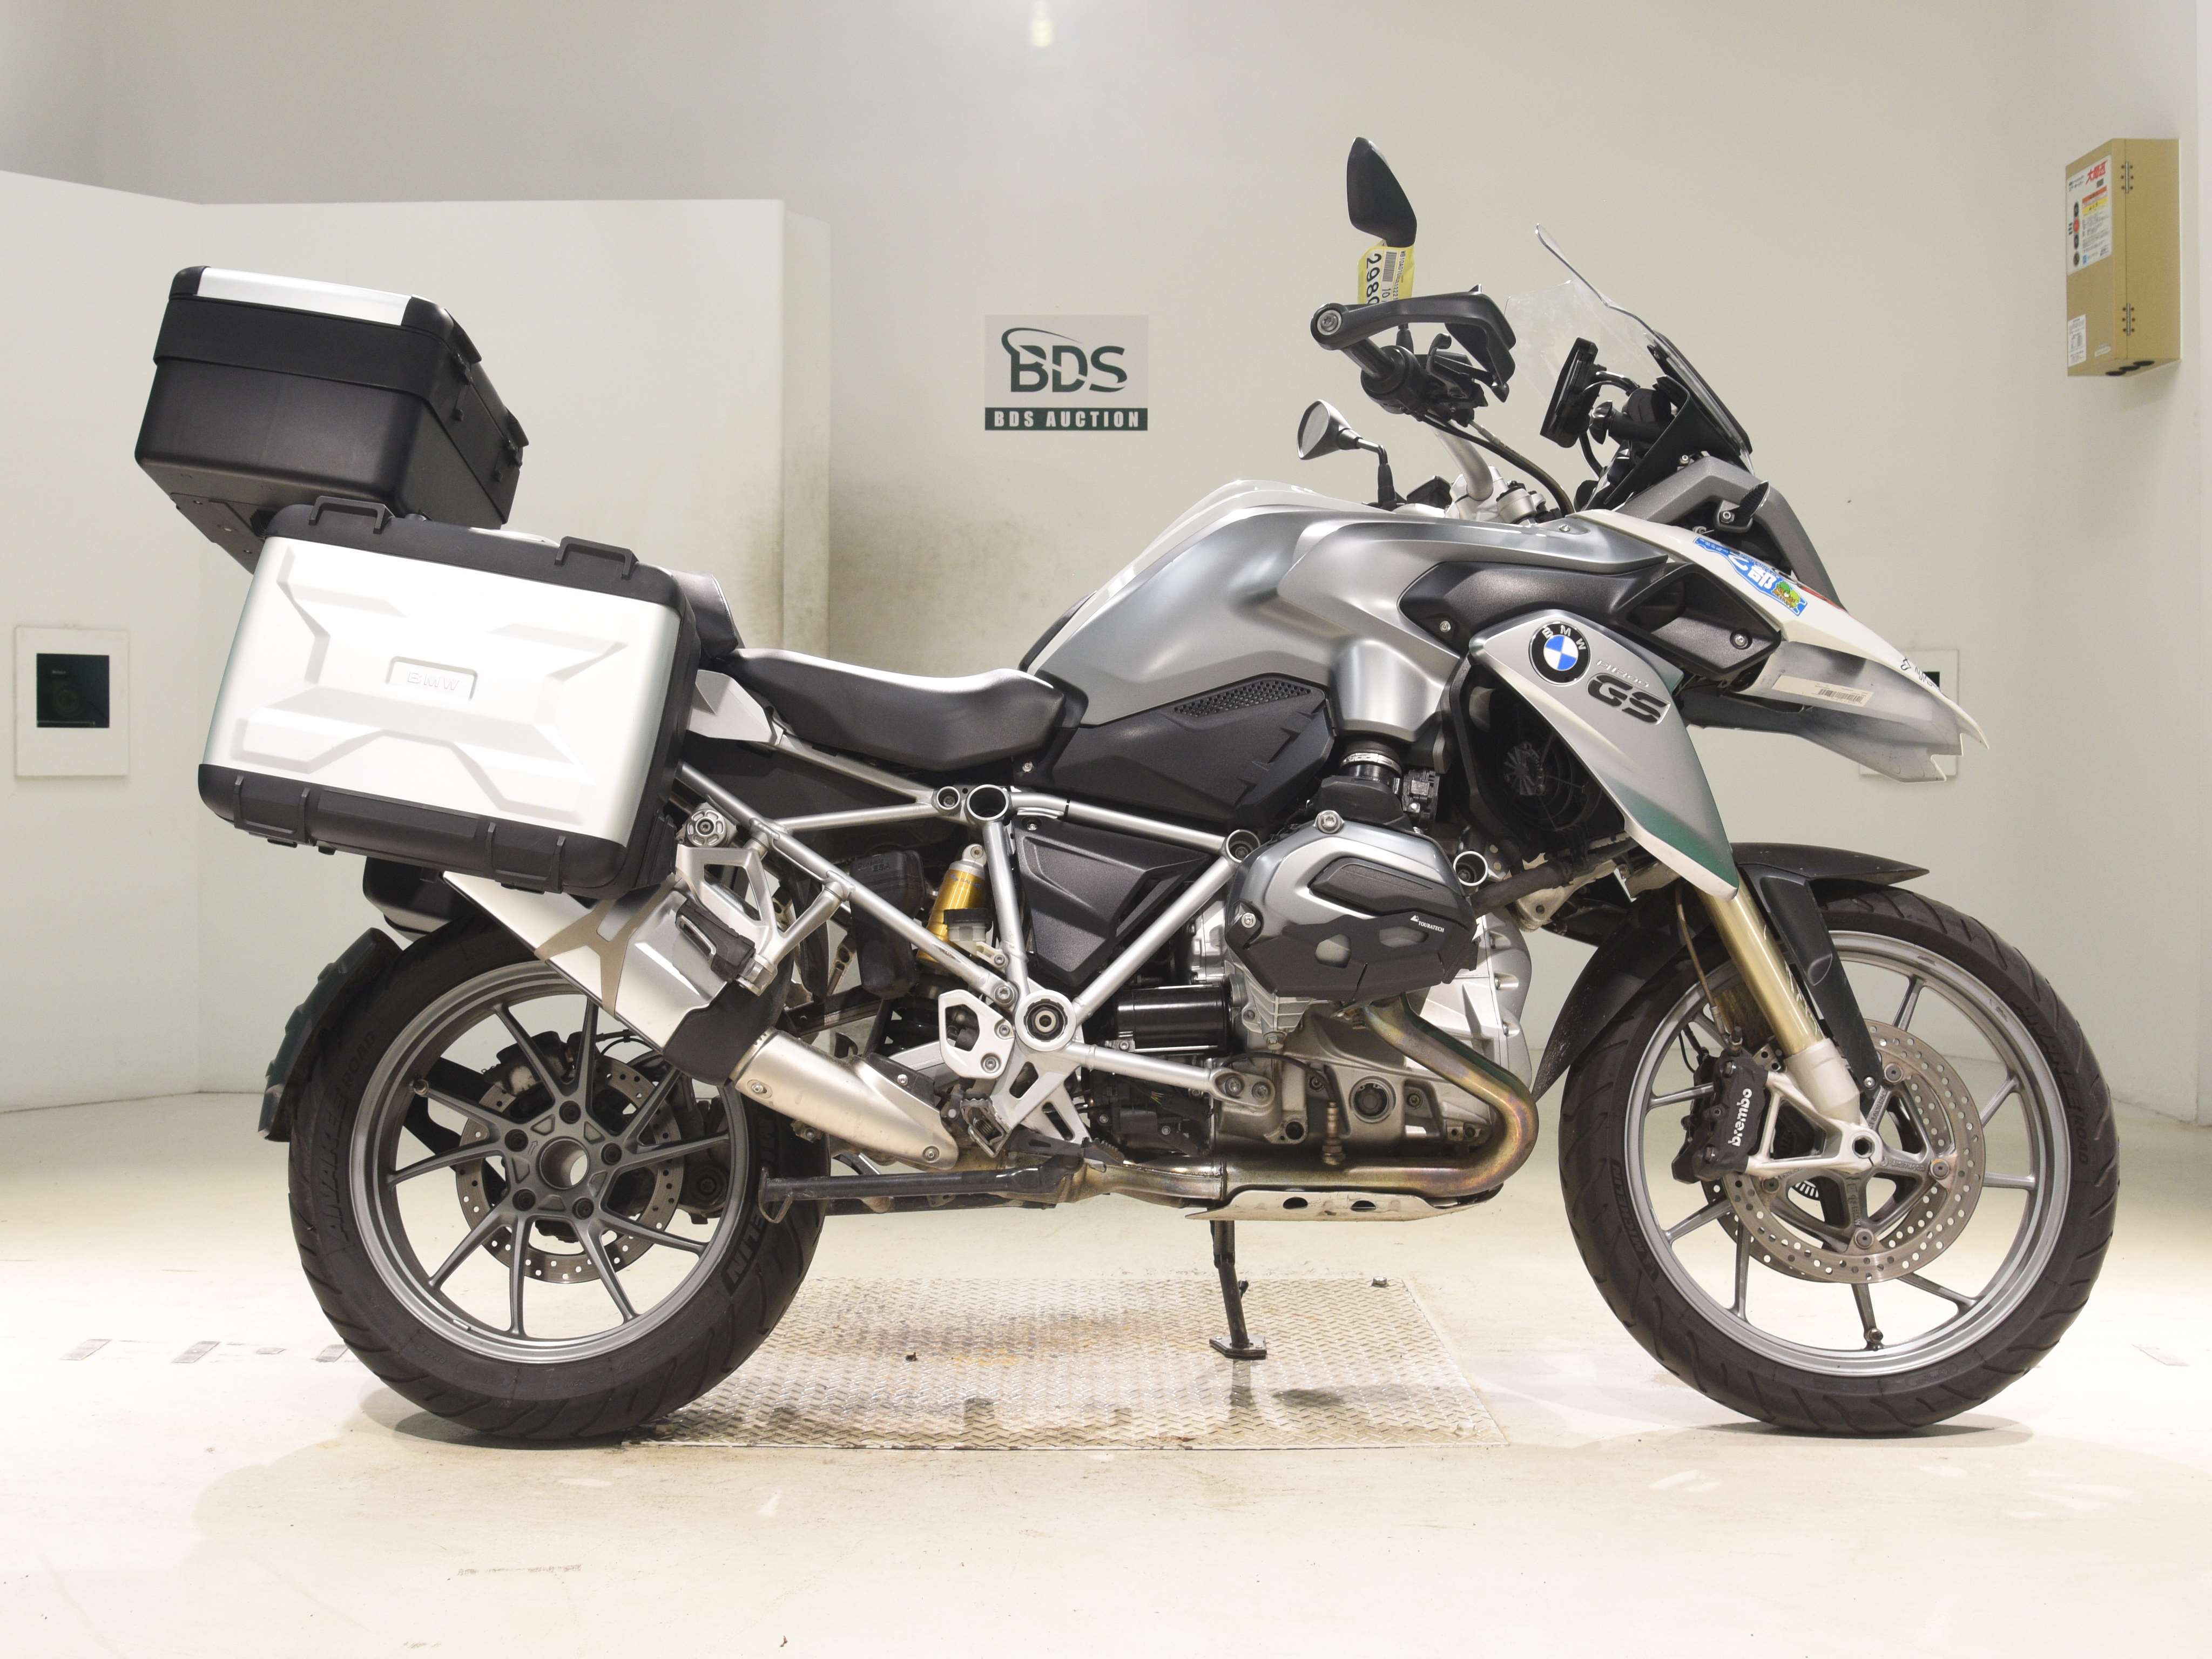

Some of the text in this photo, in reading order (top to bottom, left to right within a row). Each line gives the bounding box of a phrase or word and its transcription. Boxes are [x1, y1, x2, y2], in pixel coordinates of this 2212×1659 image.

[1002, 328, 1128, 393] BDS
[994, 411, 1139, 427] BDS AUCTION
[1542, 625, 1587, 651] BMW
[407, 671, 460, 691] BMW
[1587, 673, 1671, 725] GS
[1418, 921, 1445, 933] TOURATECH
[1728, 1088, 1752, 1147] brembo
